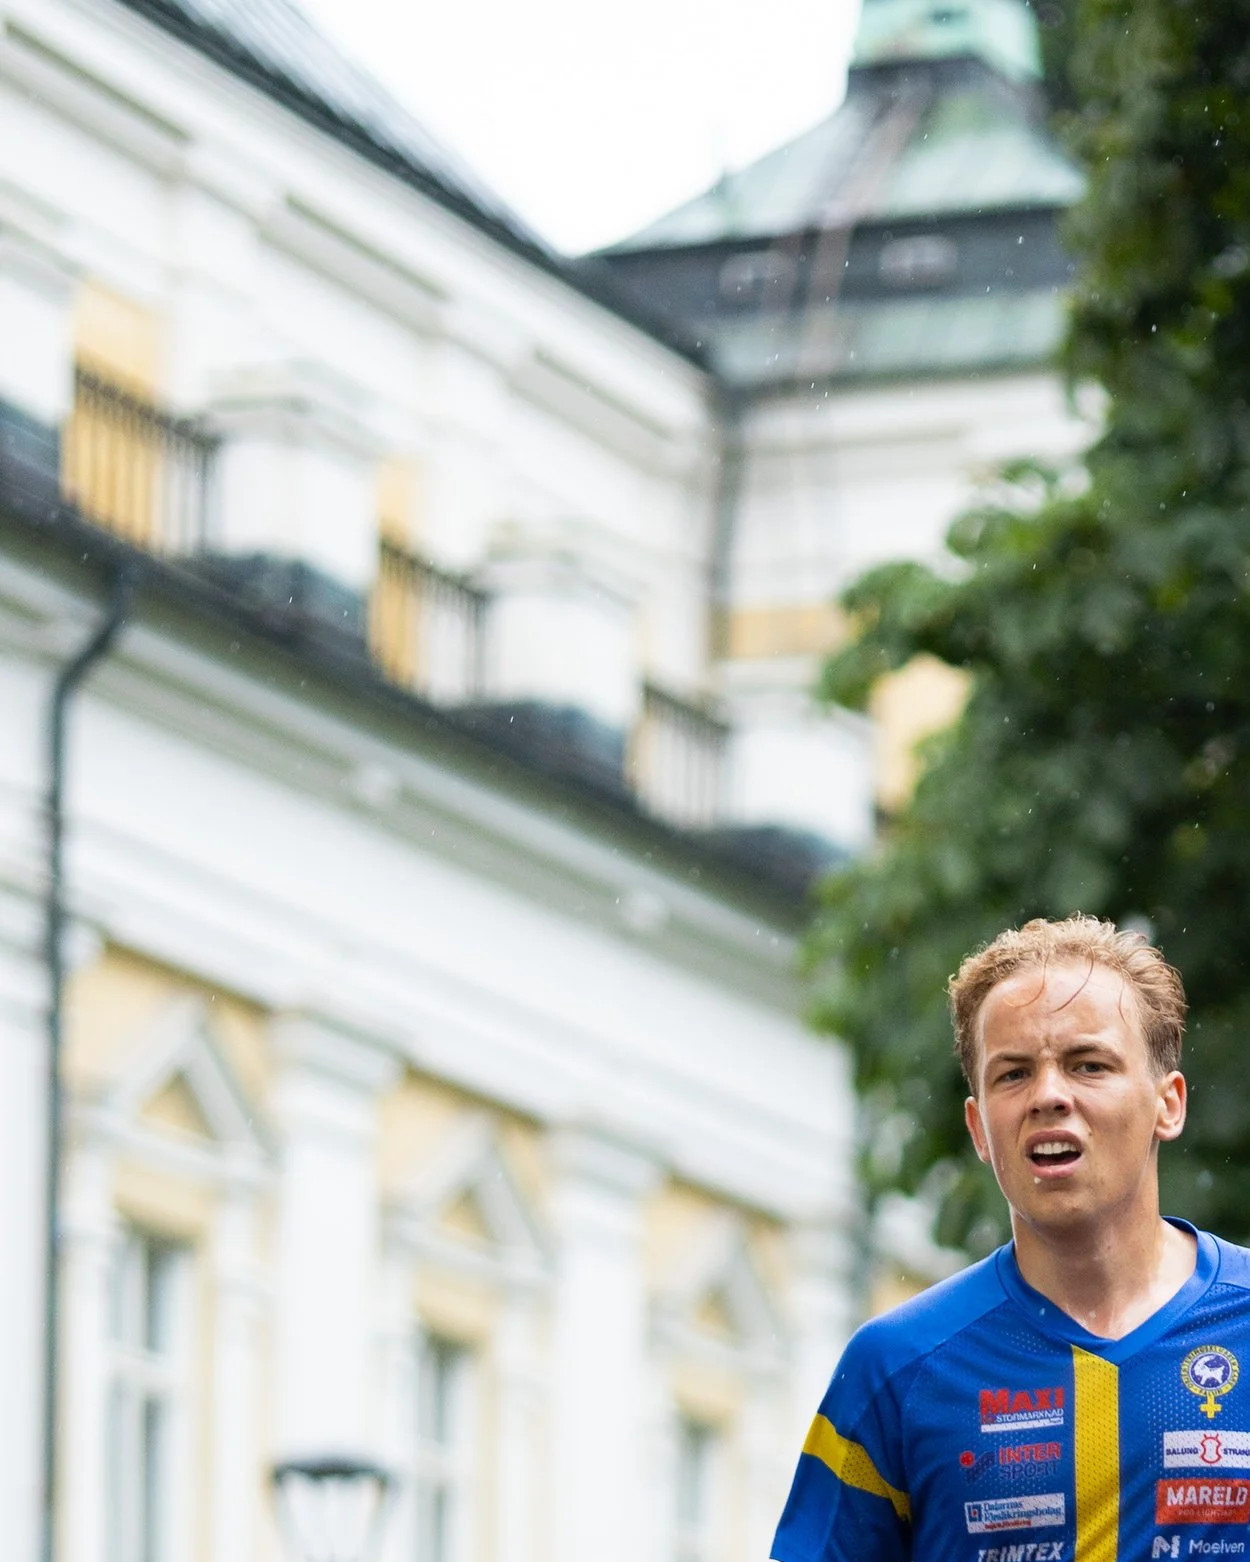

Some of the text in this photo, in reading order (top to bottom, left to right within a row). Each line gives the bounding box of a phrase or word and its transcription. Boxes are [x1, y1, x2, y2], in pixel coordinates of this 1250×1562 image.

[980, 1387, 1064, 1415] MAXI
[996, 1408, 1064, 1423] STORMARKNAD
[999, 1442, 1062, 1465] INTER
[1000, 1461, 1057, 1480] SPORT
[1166, 1485, 1248, 1507] MARELD
[1189, 1539, 1245, 1554] Moelven
